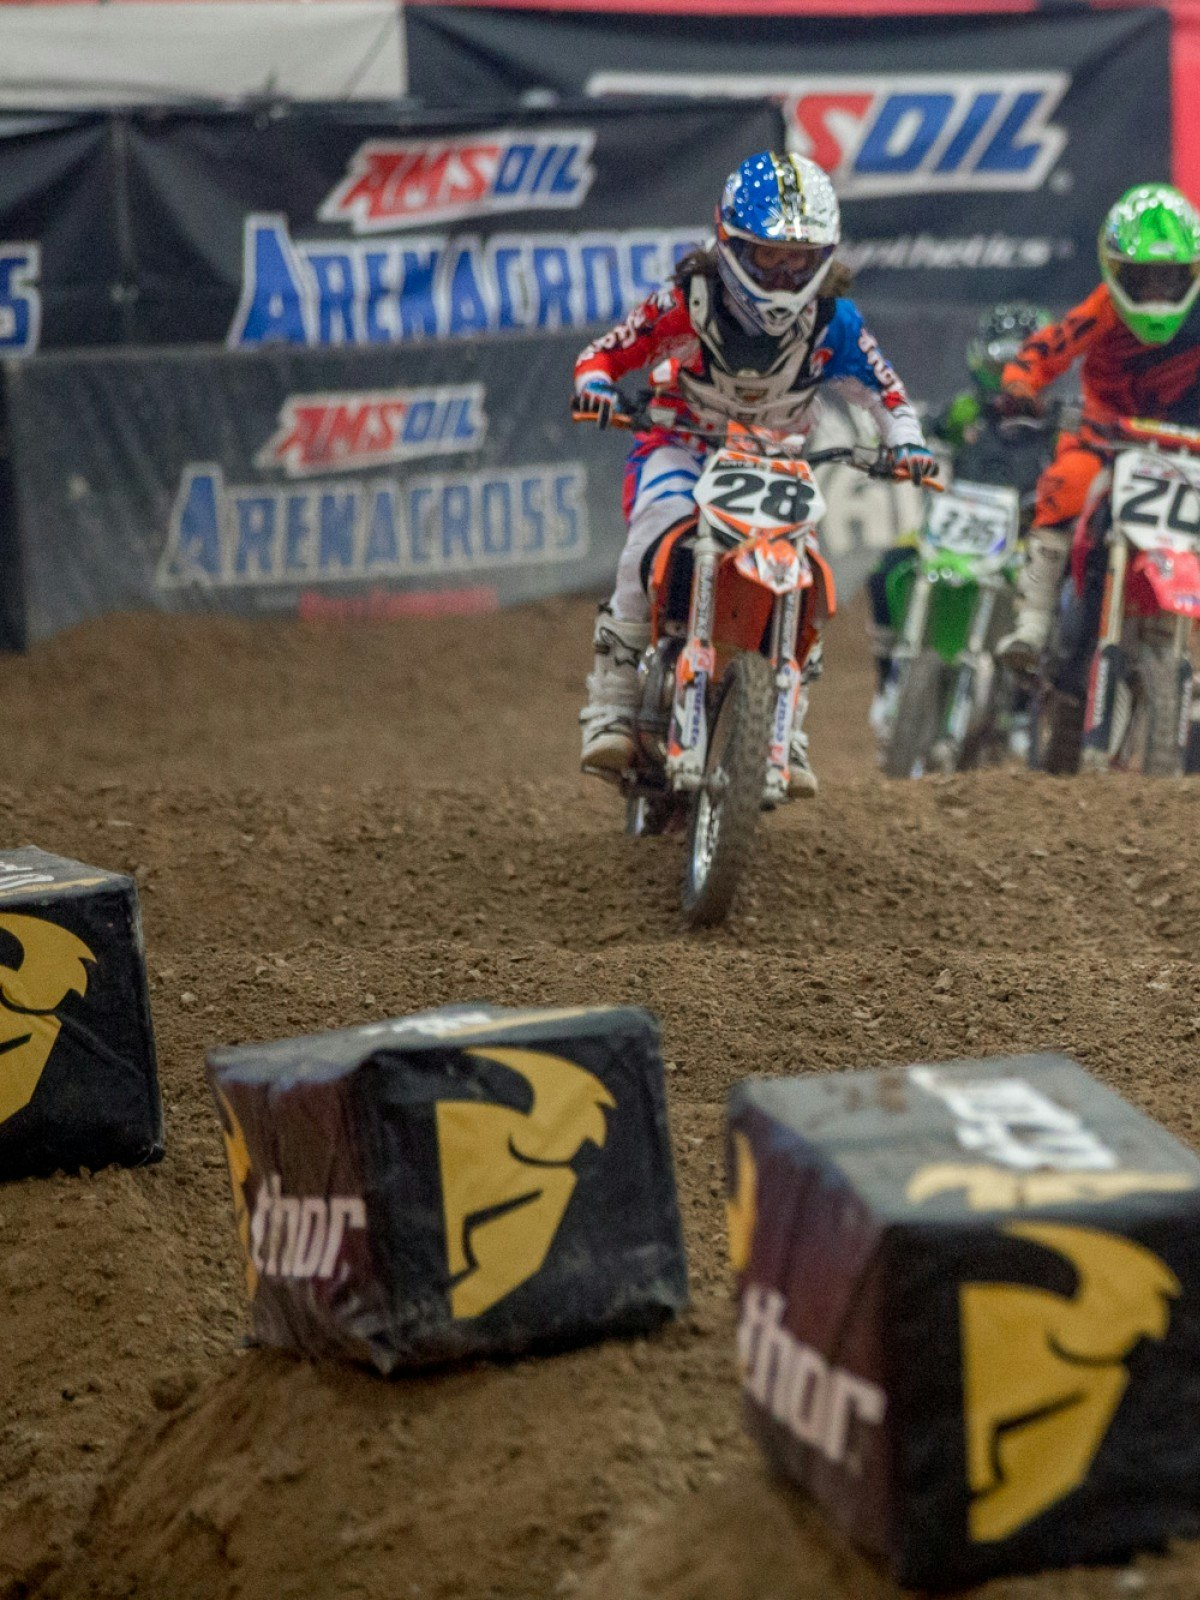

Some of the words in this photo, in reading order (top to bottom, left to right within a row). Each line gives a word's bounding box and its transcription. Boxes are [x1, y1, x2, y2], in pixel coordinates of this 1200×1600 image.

[788, 84, 1058, 182] SOIL
[328, 134, 594, 230] AMSOIL
[836, 235, 1048, 276] ynthetics
[264, 388, 483, 475] AMSOIL
[160, 464, 588, 588] ARENACROSS
[707, 472, 814, 523] 28
[251, 1174, 366, 1278] thor
[737, 1284, 887, 1462] thor
